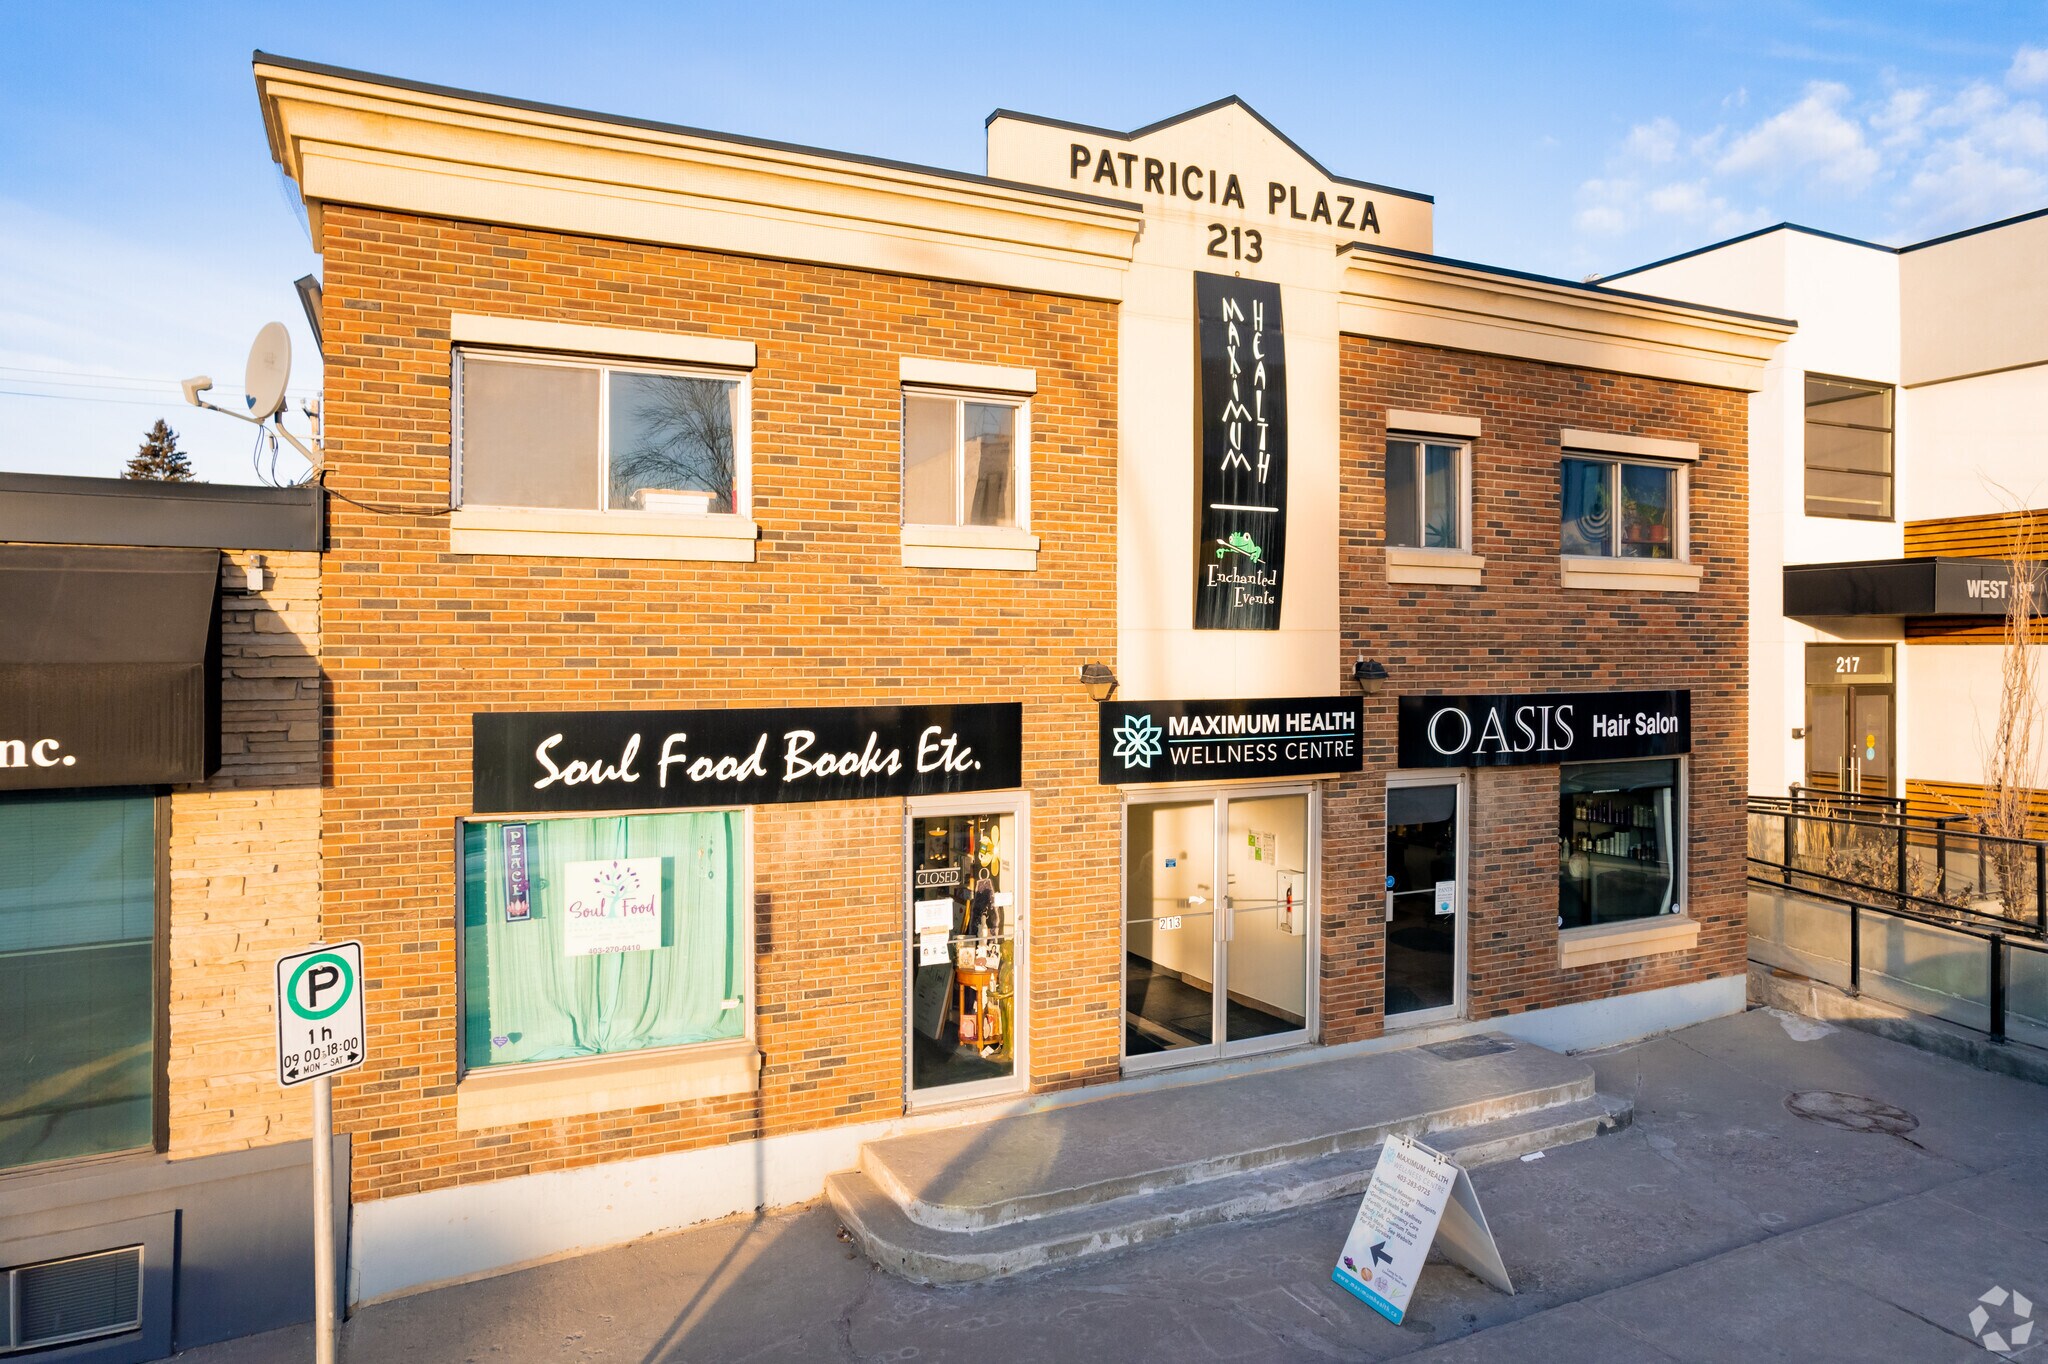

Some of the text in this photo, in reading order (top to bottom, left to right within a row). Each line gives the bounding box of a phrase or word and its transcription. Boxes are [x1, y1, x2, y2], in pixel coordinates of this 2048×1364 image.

[1070, 143, 1381, 234] PATRICIA PLAZA
[1207, 223, 1263, 263] 213
[1253, 299, 1270, 484] HEALTH
[1207, 564, 1277, 587] Enchanted
[1234, 587, 1275, 608] Events
[1967, 579, 2008, 599] WEST
[1836, 656, 1860, 673] 217
[1168, 711, 1355, 736] MAXIMUM HEALTH
[1427, 704, 1679, 755] OASIS Hair Salon
[534, 725, 982, 789] Soul Food Books Etc.
[1169, 740, 1354, 765] WELLNESS CENTRE
[510, 831, 523, 896] PEACE
[917, 870, 959, 885] CLOSED
[569, 894, 655, 918] Soul Food
[1160, 917, 1181, 930] 213
[588, 944, 641, 954] 403-270-0410
[309, 966, 339, 1008] P
[303, 1061, 321, 1074] MON
[330, 1056, 344, 1067] SAT
[1394, 1163, 1445, 1194] WELLNESS CENTRE
[1396, 1152, 1449, 1184] MAXIMUM HEALTH
